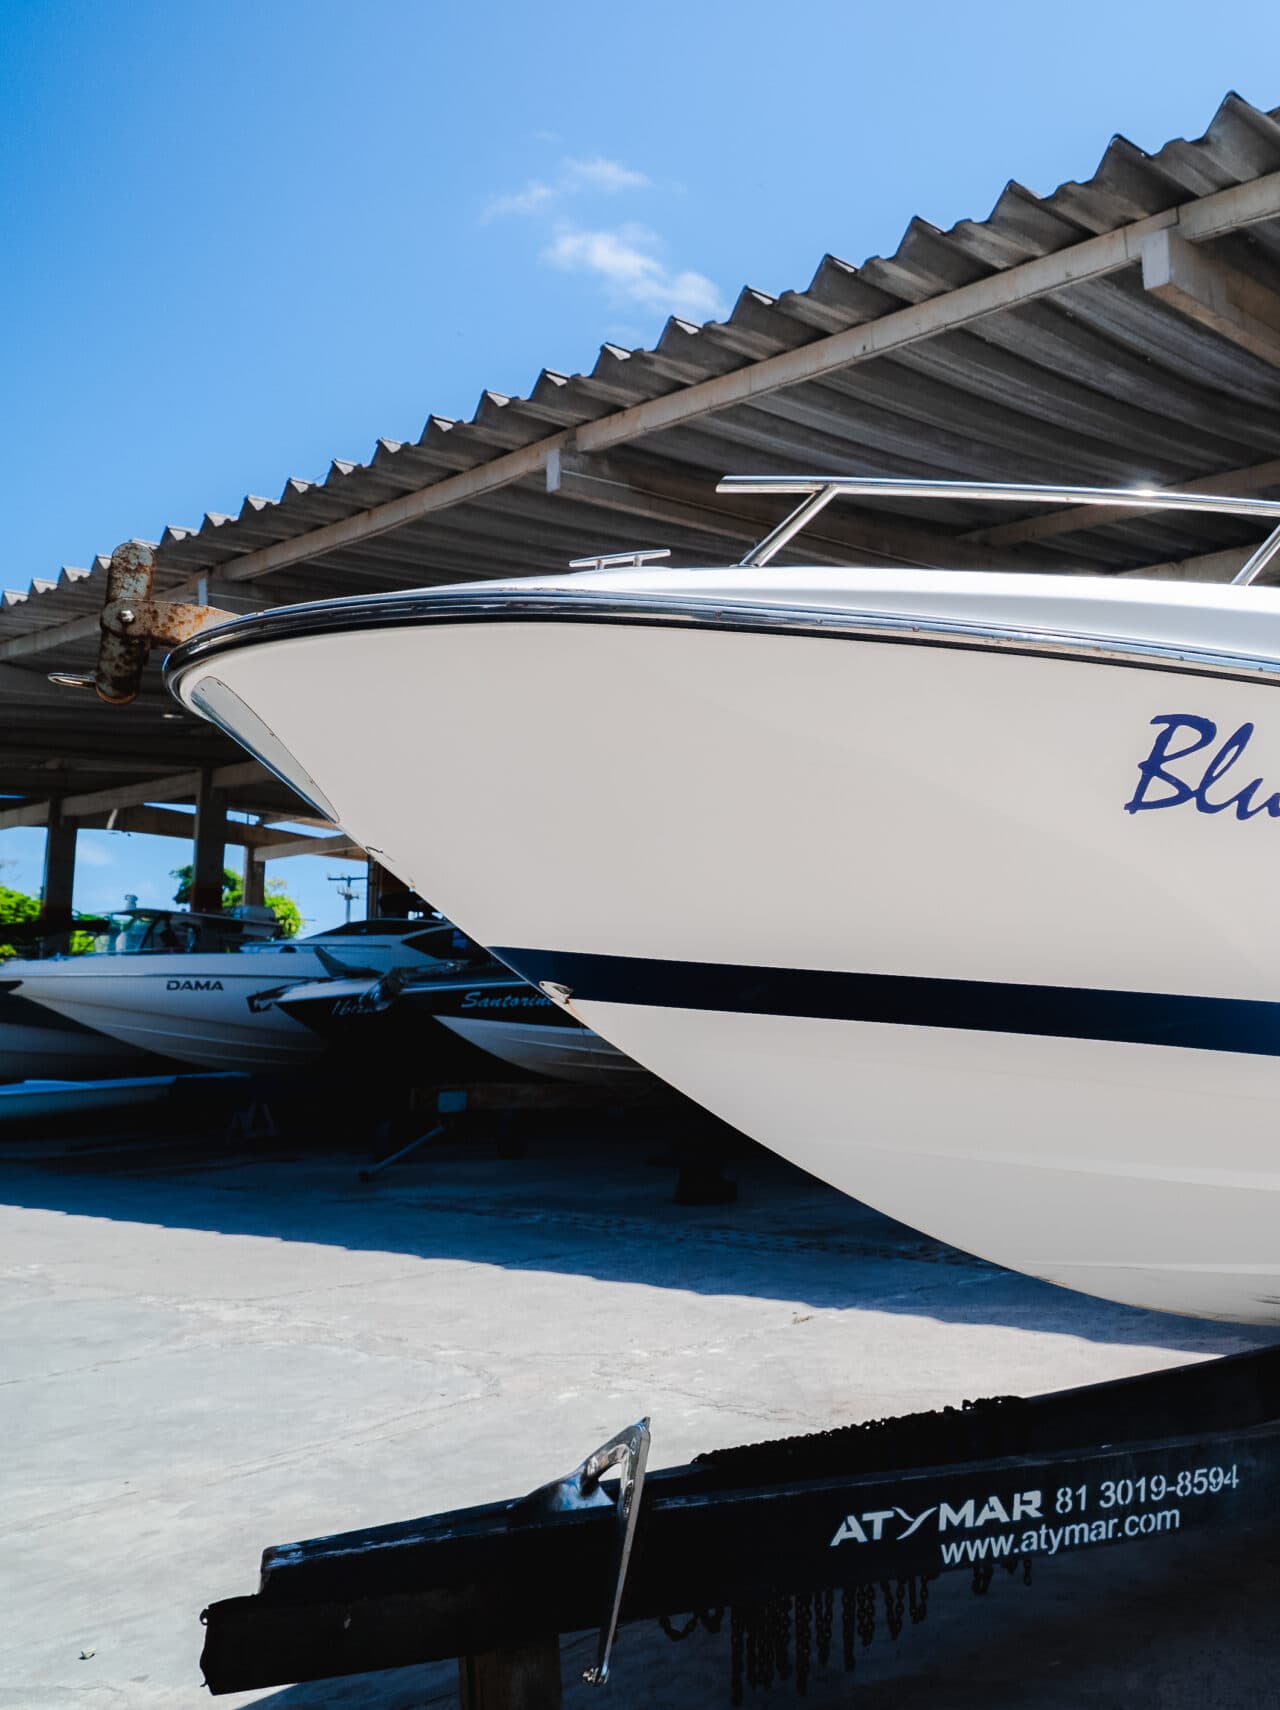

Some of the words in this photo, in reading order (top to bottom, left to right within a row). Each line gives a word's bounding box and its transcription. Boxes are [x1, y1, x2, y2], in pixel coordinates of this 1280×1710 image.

[166, 979, 224, 991] DAMA
[1055, 1486, 1088, 1514] 81
[1099, 1463, 1240, 1508] 3019-8594
[940, 1508, 1181, 1565] www.atymar.com
